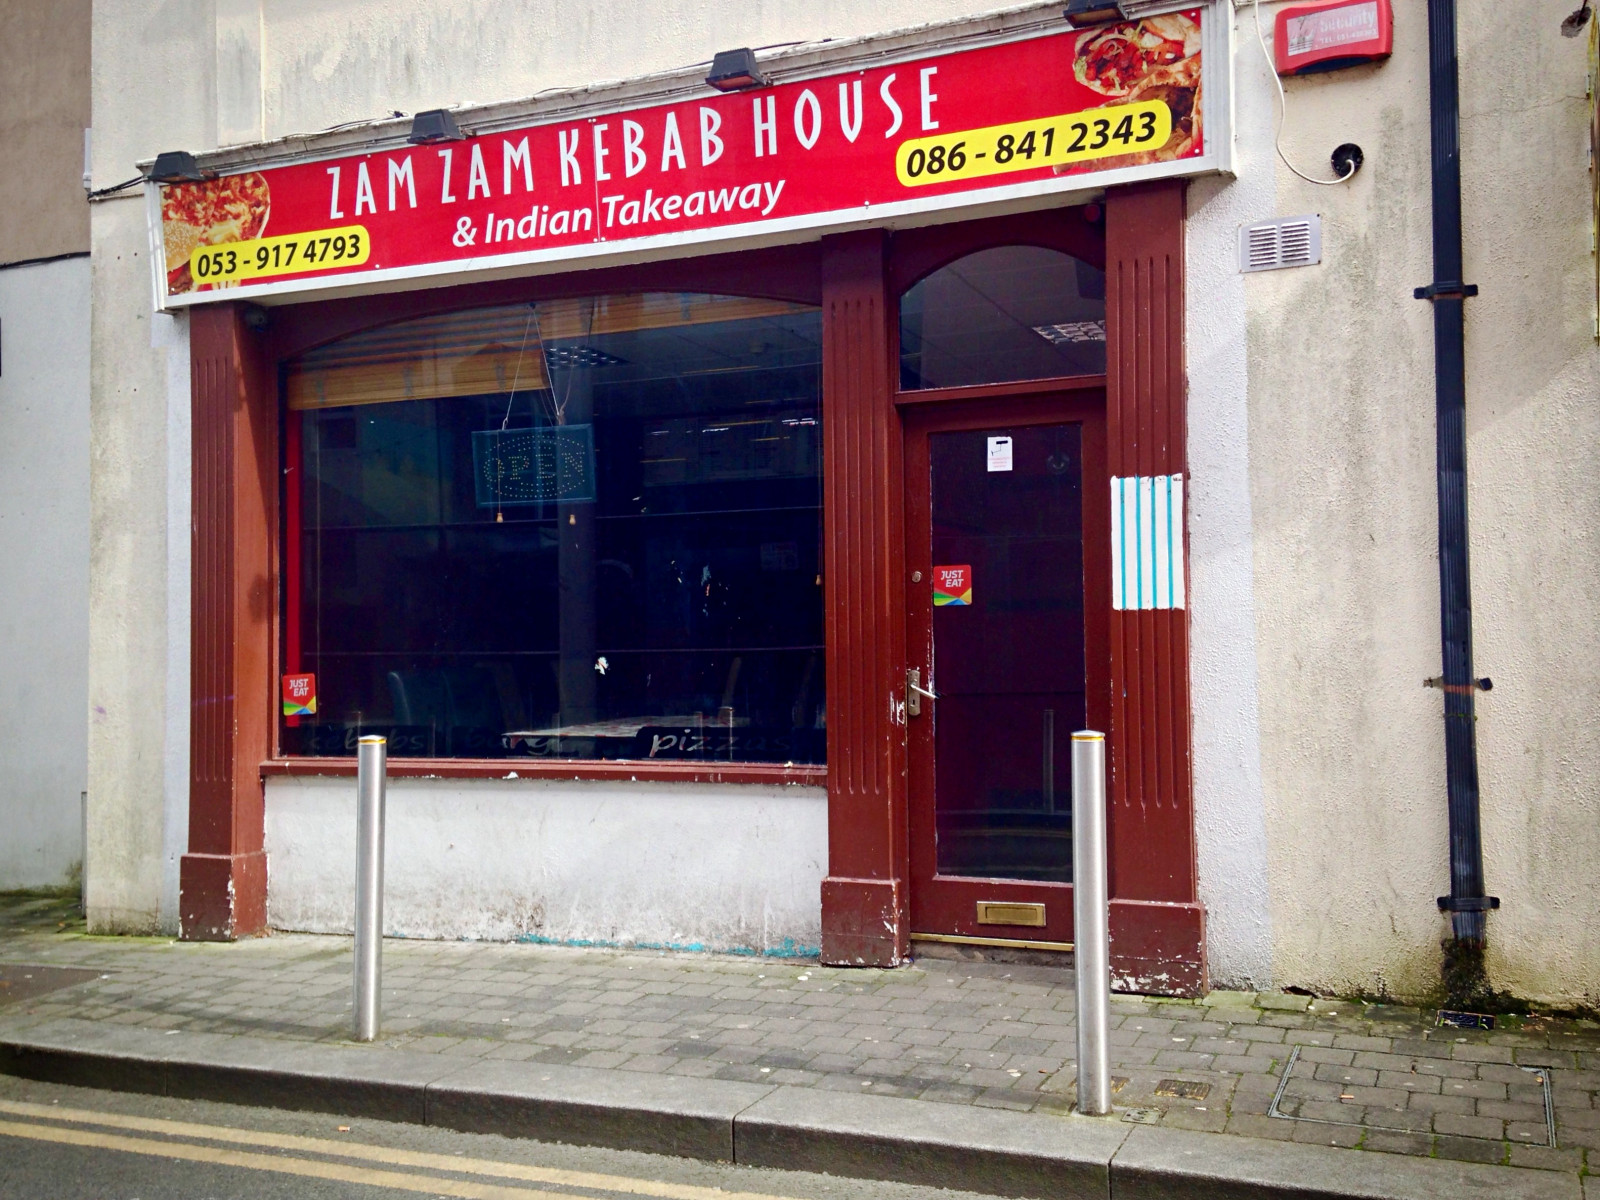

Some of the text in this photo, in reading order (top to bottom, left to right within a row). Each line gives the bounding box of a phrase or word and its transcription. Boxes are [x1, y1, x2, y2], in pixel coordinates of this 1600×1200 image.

[326, 66, 940, 220] ZAM ZAM KEBAB HOUSE
[907, 142, 966, 178] 086
[994, 127, 1055, 164] 841
[1066, 112, 1157, 153] 2343
[452, 180, 786, 248] & Indian Takeaway
[197, 250, 237, 278] 053
[256, 243, 298, 270] 917
[303, 235, 360, 263] 4793
[483, 451, 586, 482] OPEN
[940, 569, 964, 581] JUST
[945, 578, 964, 588] EAT
[288, 677, 309, 690] JUST
[293, 687, 309, 697] EAT
[306, 727, 425, 750] kebbs
[648, 727, 790, 758] pizzas
